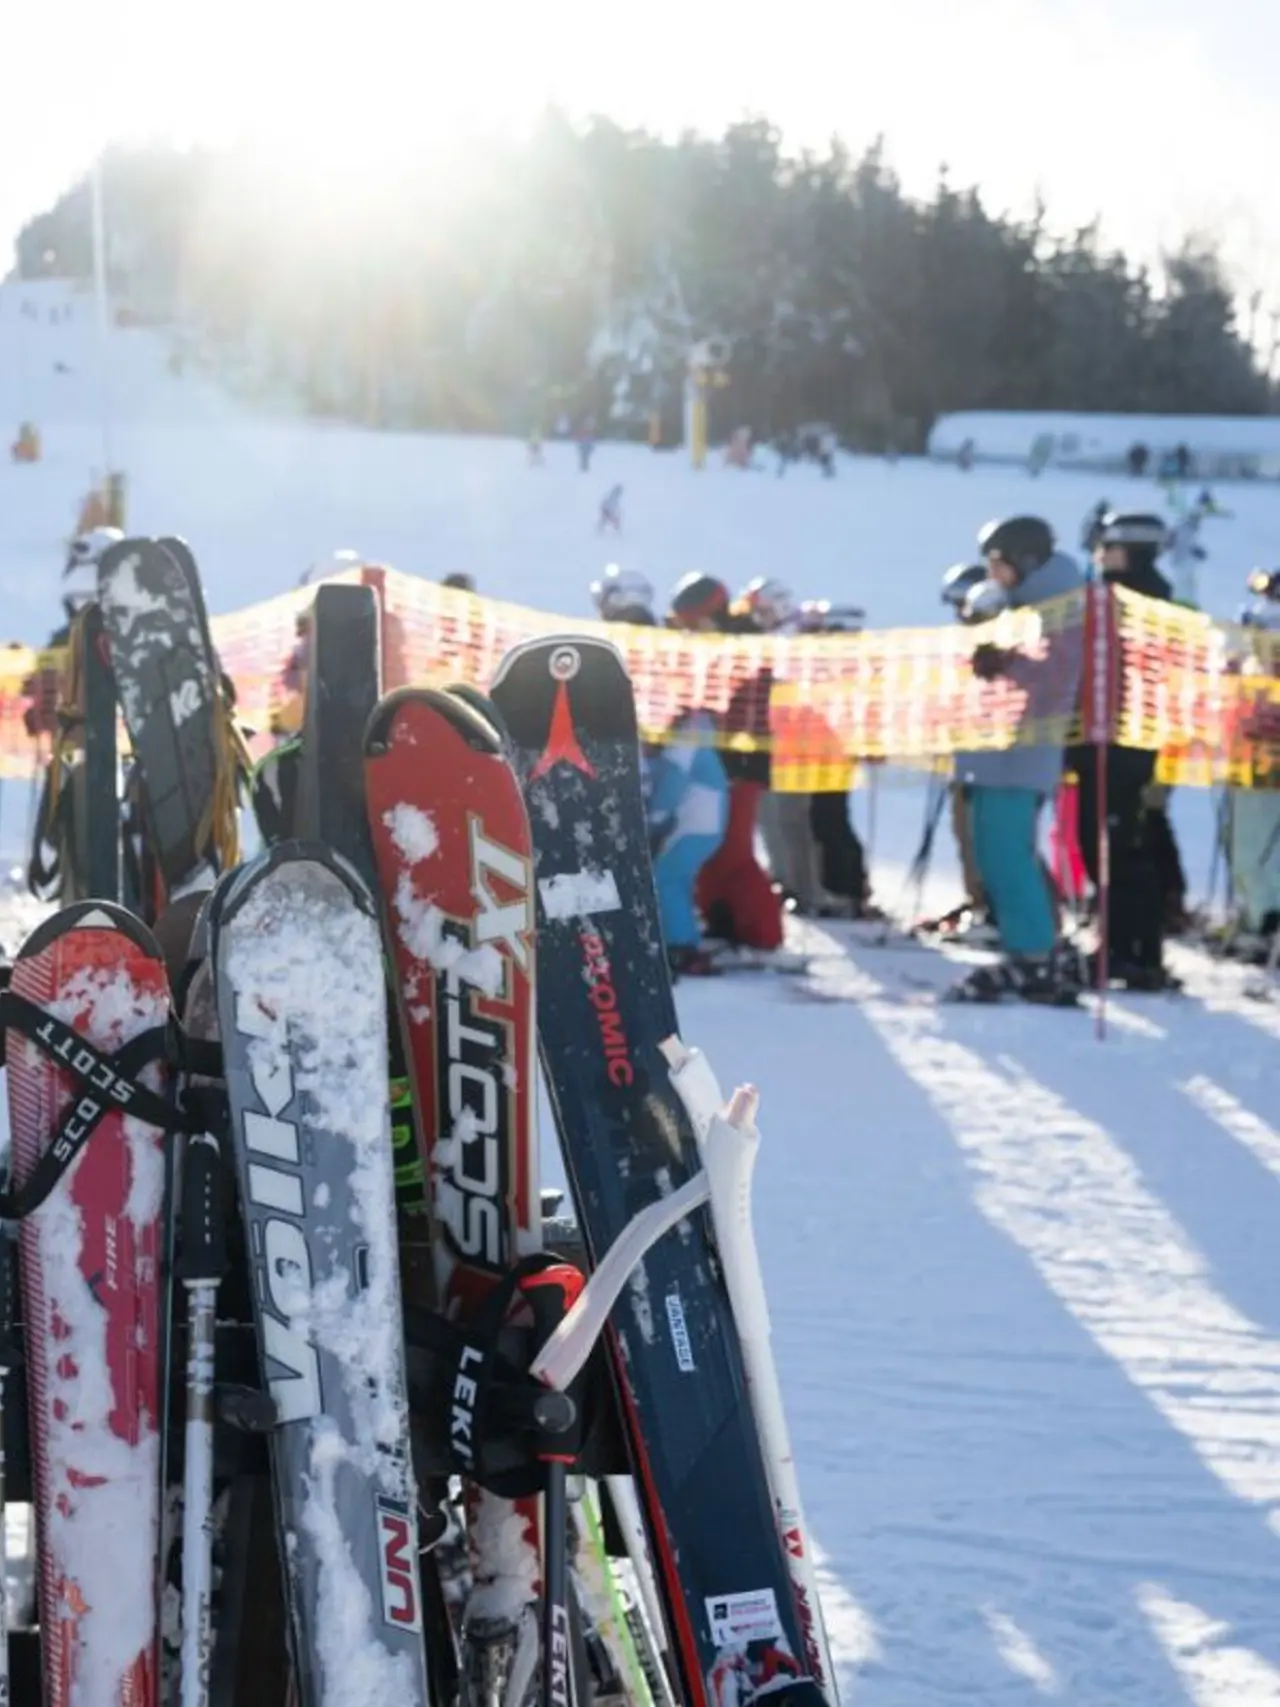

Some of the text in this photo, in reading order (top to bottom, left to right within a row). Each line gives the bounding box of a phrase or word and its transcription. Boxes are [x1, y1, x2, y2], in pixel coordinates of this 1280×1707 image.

[171, 679, 201, 726] K2
[470, 815, 531, 972] XT
[579, 931, 634, 1088] ATOMIC
[36, 1021, 135, 1103] SCOTT
[53, 1097, 101, 1162] SCO
[104, 1217, 120, 1290] FIRE
[450, 1345, 483, 1463] LEKI
